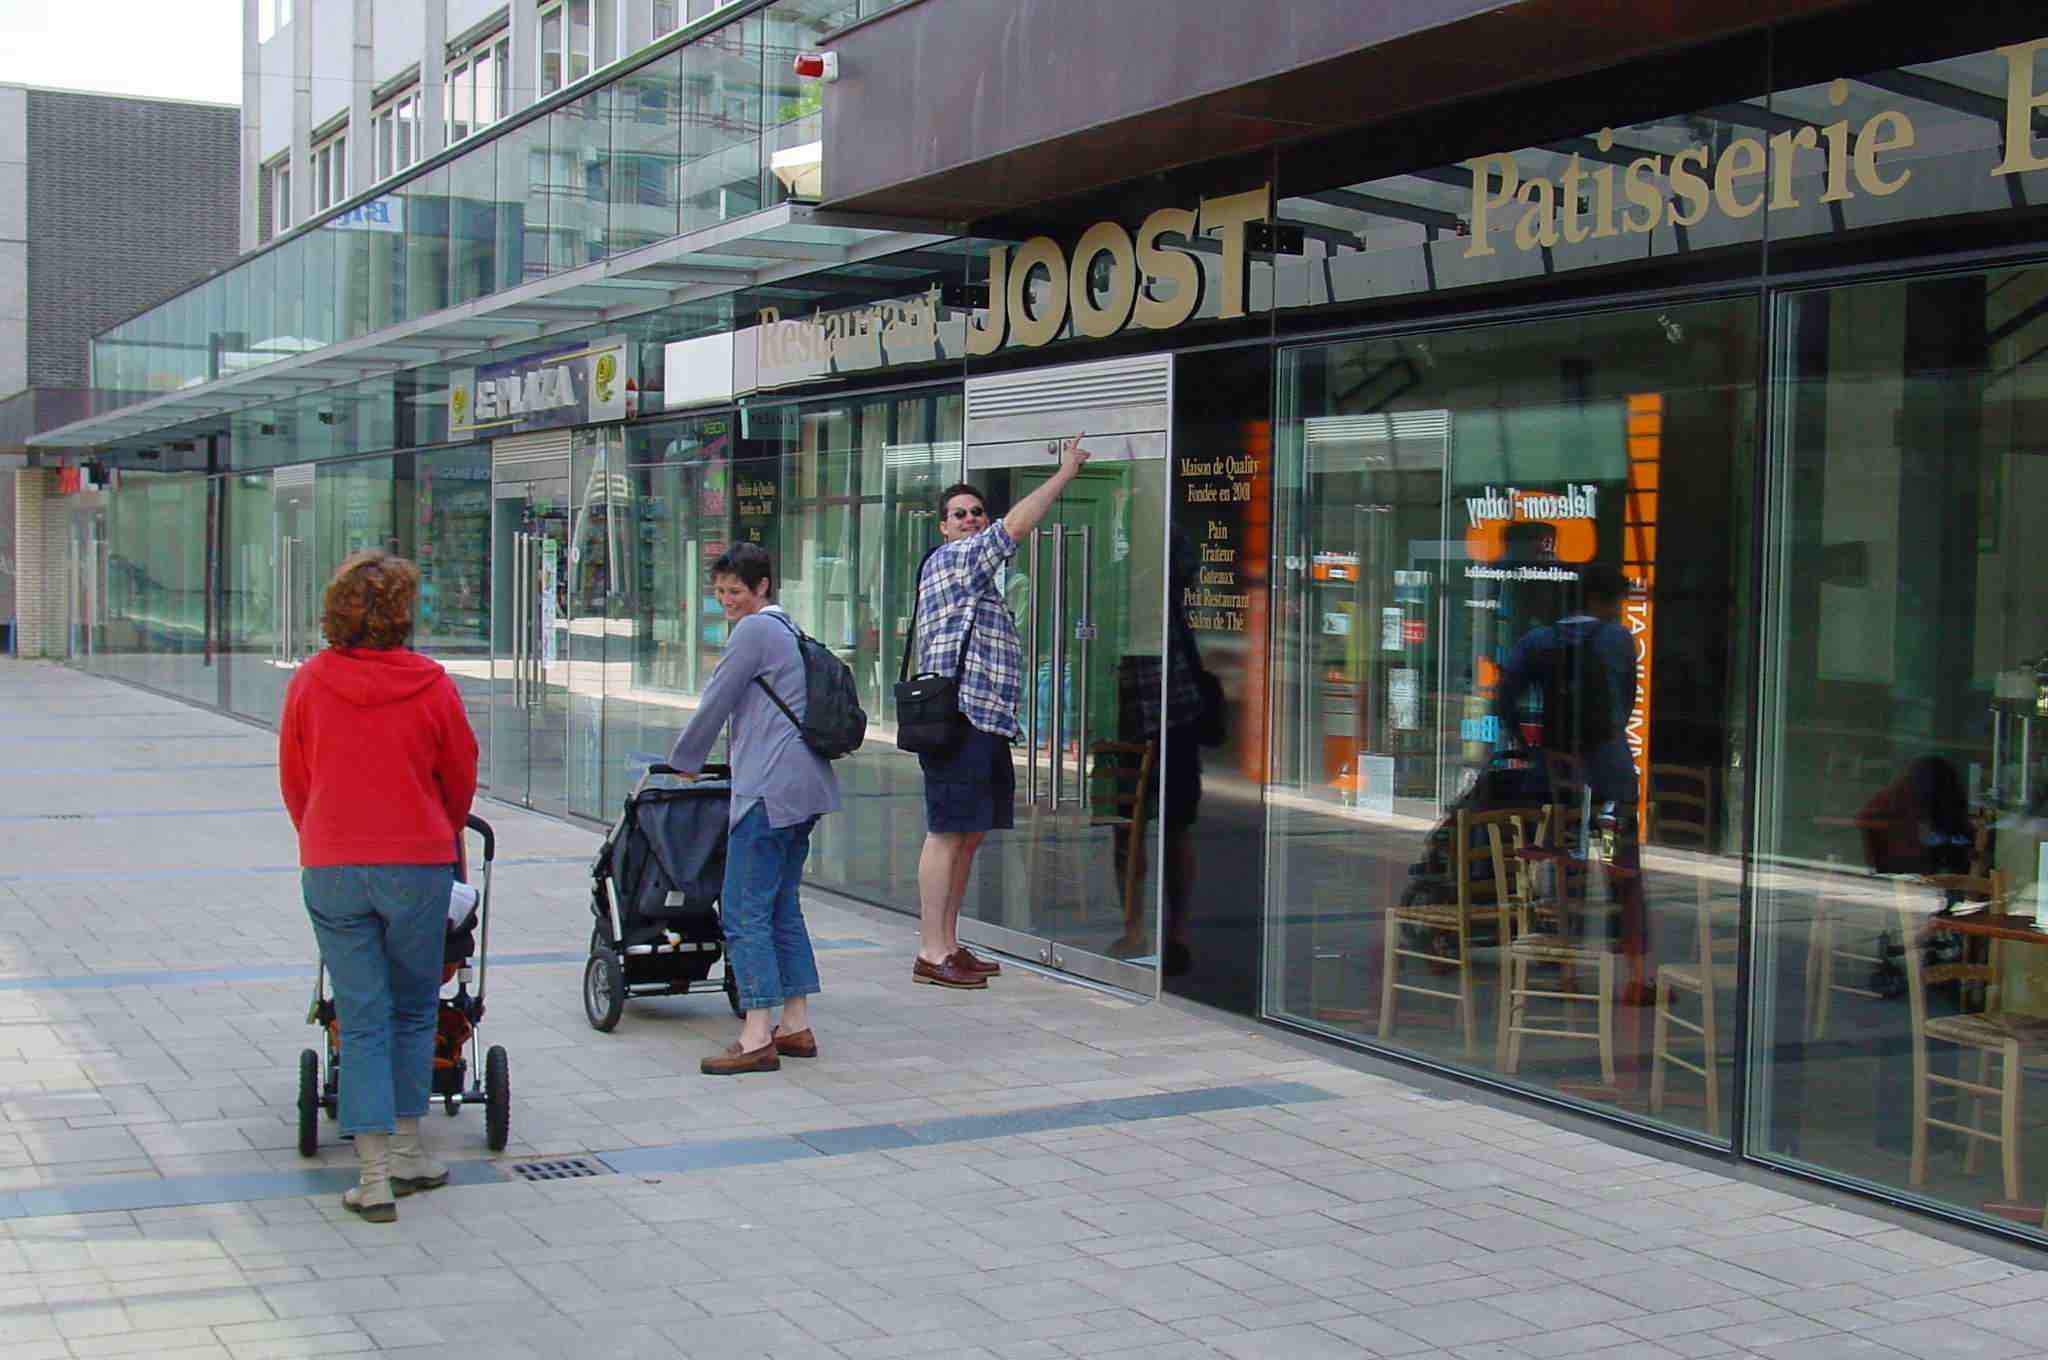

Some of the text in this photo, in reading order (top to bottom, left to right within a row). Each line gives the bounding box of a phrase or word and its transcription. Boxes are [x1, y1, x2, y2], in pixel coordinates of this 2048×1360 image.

[758, 281, 944, 370] Restaurant
[965, 182, 1271, 356] JOOST
[1463, 77, 1916, 258] Patisserie
[1181, 455, 1260, 480] Maison de Quality
[1219, 488, 1230, 502] en
[1208, 520, 1228, 540] Pain
[1201, 543, 1235, 562] Traiteur
[1203, 588, 1249, 608] Restaurant
[1188, 610, 1211, 629] Salon
[1213, 611, 1224, 630] de
